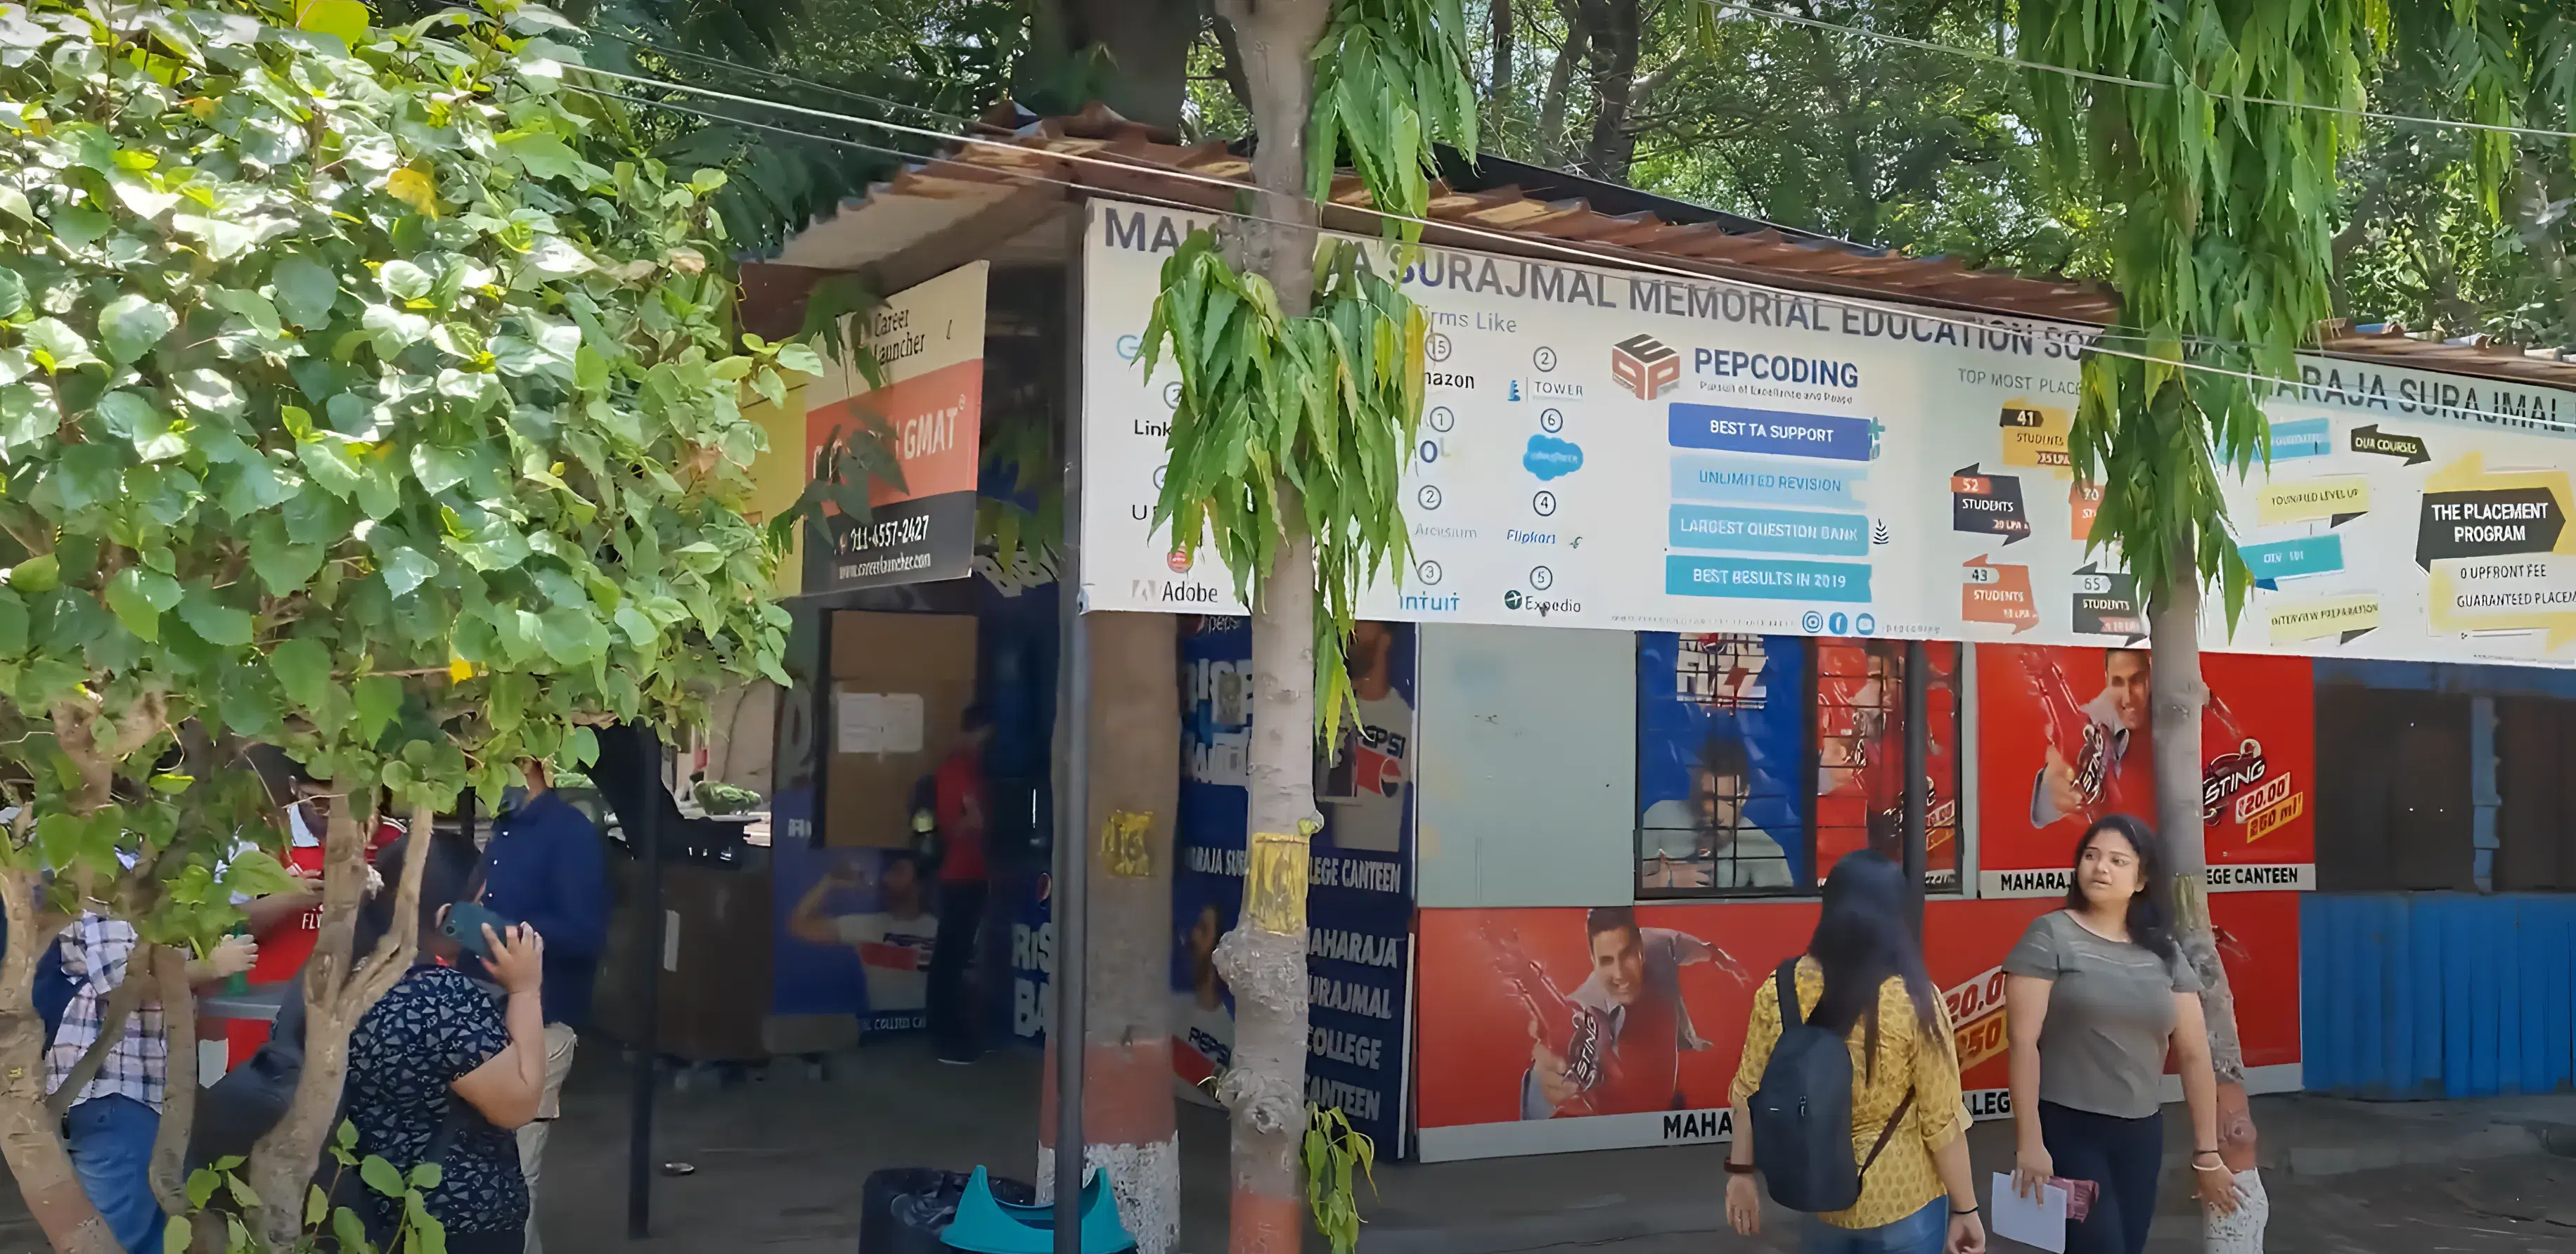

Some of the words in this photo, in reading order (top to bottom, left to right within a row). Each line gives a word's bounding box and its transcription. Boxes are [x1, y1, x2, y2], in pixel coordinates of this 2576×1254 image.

[1389, 244, 1617, 310] SURAJMAL
[1629, 278, 1830, 332] MEMORIAL
[1842, 305, 2033, 356] EDUCATION
[1476, 312, 1517, 334] Like
[1694, 347, 1858, 388] PEPCODING
[1958, 368, 1986, 385] TOP
[1991, 373, 2033, 390] MOST
[2016, 410, 2034, 427] 41
[1710, 419, 1746, 436] BEST
[1749, 422, 1767, 437] TA
[1770, 425, 1834, 442] SUPPORT
[1699, 469, 1775, 489] UNLIMITED
[1779, 476, 1841, 492] REVISION
[1962, 478, 1979, 492] 52
[2431, 503, 2461, 521] THE
[2464, 502, 2549, 520] PLACEMENT
[1680, 517, 1744, 535] LARGEST
[1747, 521, 1817, 539] QUESTION
[1821, 526, 1858, 542] BANK
[2454, 525, 2526, 543] PROGRAM
[1693, 568, 1729, 584] BEST
[1732, 570, 1793, 586] RESULTS
[1796, 573, 1810, 586] IN
[1814, 574, 1846, 588] 2019
[2471, 564, 2524, 580] UPFRONT
[2527, 564, 2546, 578] FEE
[1161, 581, 1218, 602] Adobe
[2084, 577, 2101, 590] 65
[2456, 593, 2532, 607] GUARANTEED
[2203, 760, 2265, 806] STING
[1341, 859, 1401, 894] CANTEEN
[2234, 867, 2298, 885] CANTEEN
[1308, 974, 1392, 1020] URAJMAL
